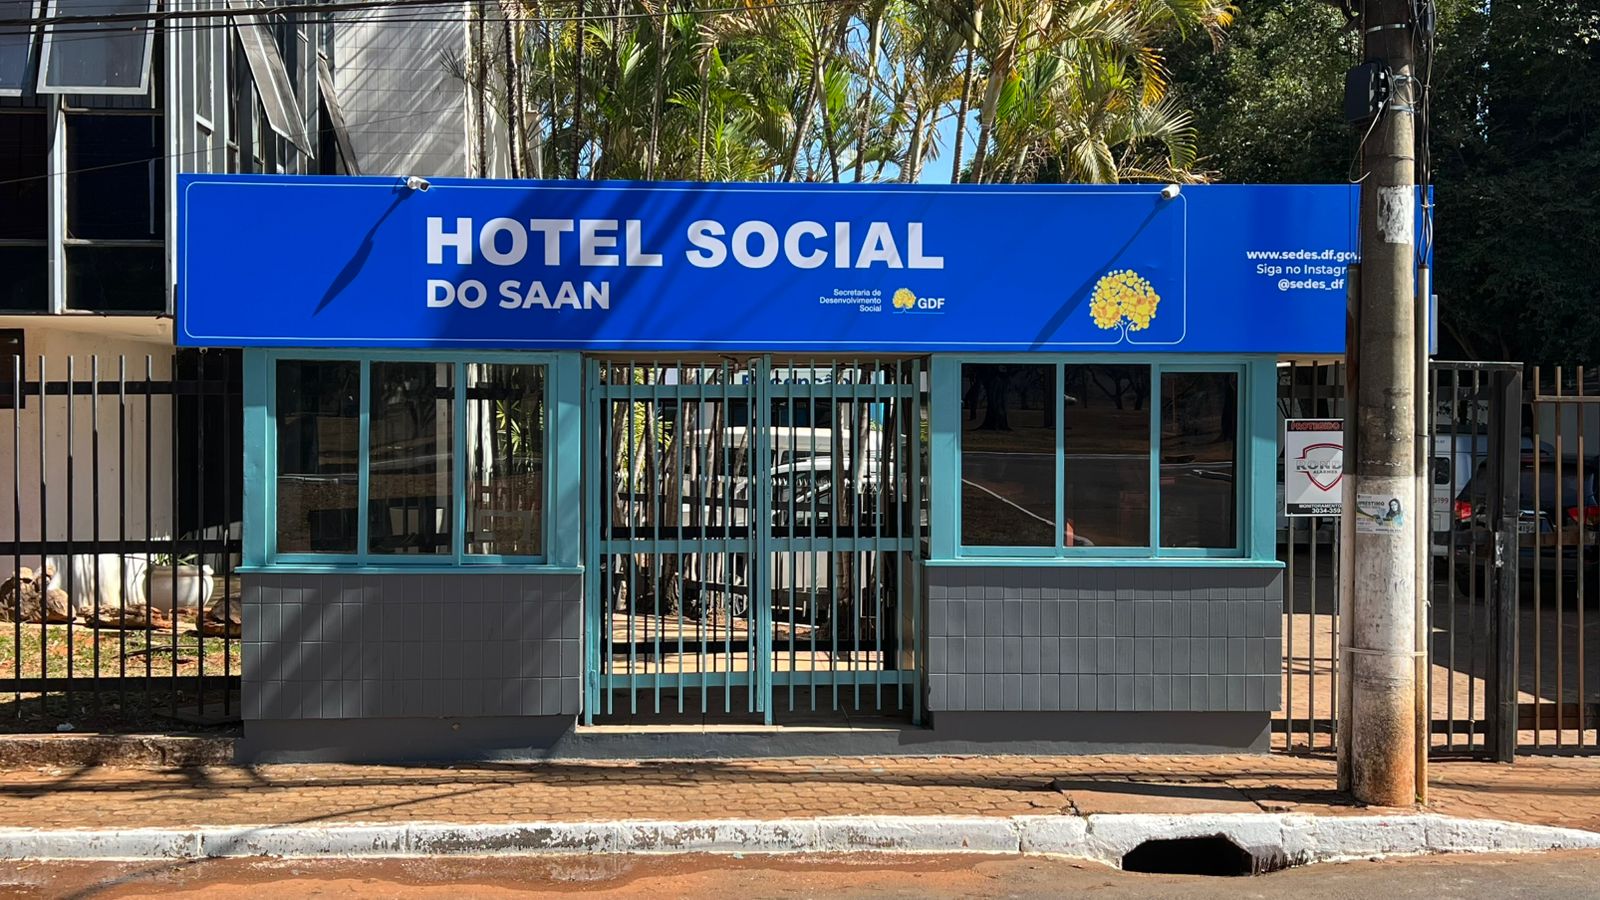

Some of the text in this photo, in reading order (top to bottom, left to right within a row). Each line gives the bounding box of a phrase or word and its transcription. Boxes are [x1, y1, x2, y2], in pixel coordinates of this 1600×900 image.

[426, 216, 945, 270] HOTEL SOCIAL
[1246, 249, 1361, 263] www.sedes.df.gov.
[1256, 264, 1347, 277] Siga no Instagr
[1277, 278, 1345, 292] @sedes_df
[426, 279, 610, 310] DO SAAN
[833, 288, 882, 297] Secretaria de
[819, 296, 882, 304] Desenvolvimento
[917, 297, 945, 310] GDF
[859, 304, 882, 312] Social
[1296, 459, 1343, 470] ROND
